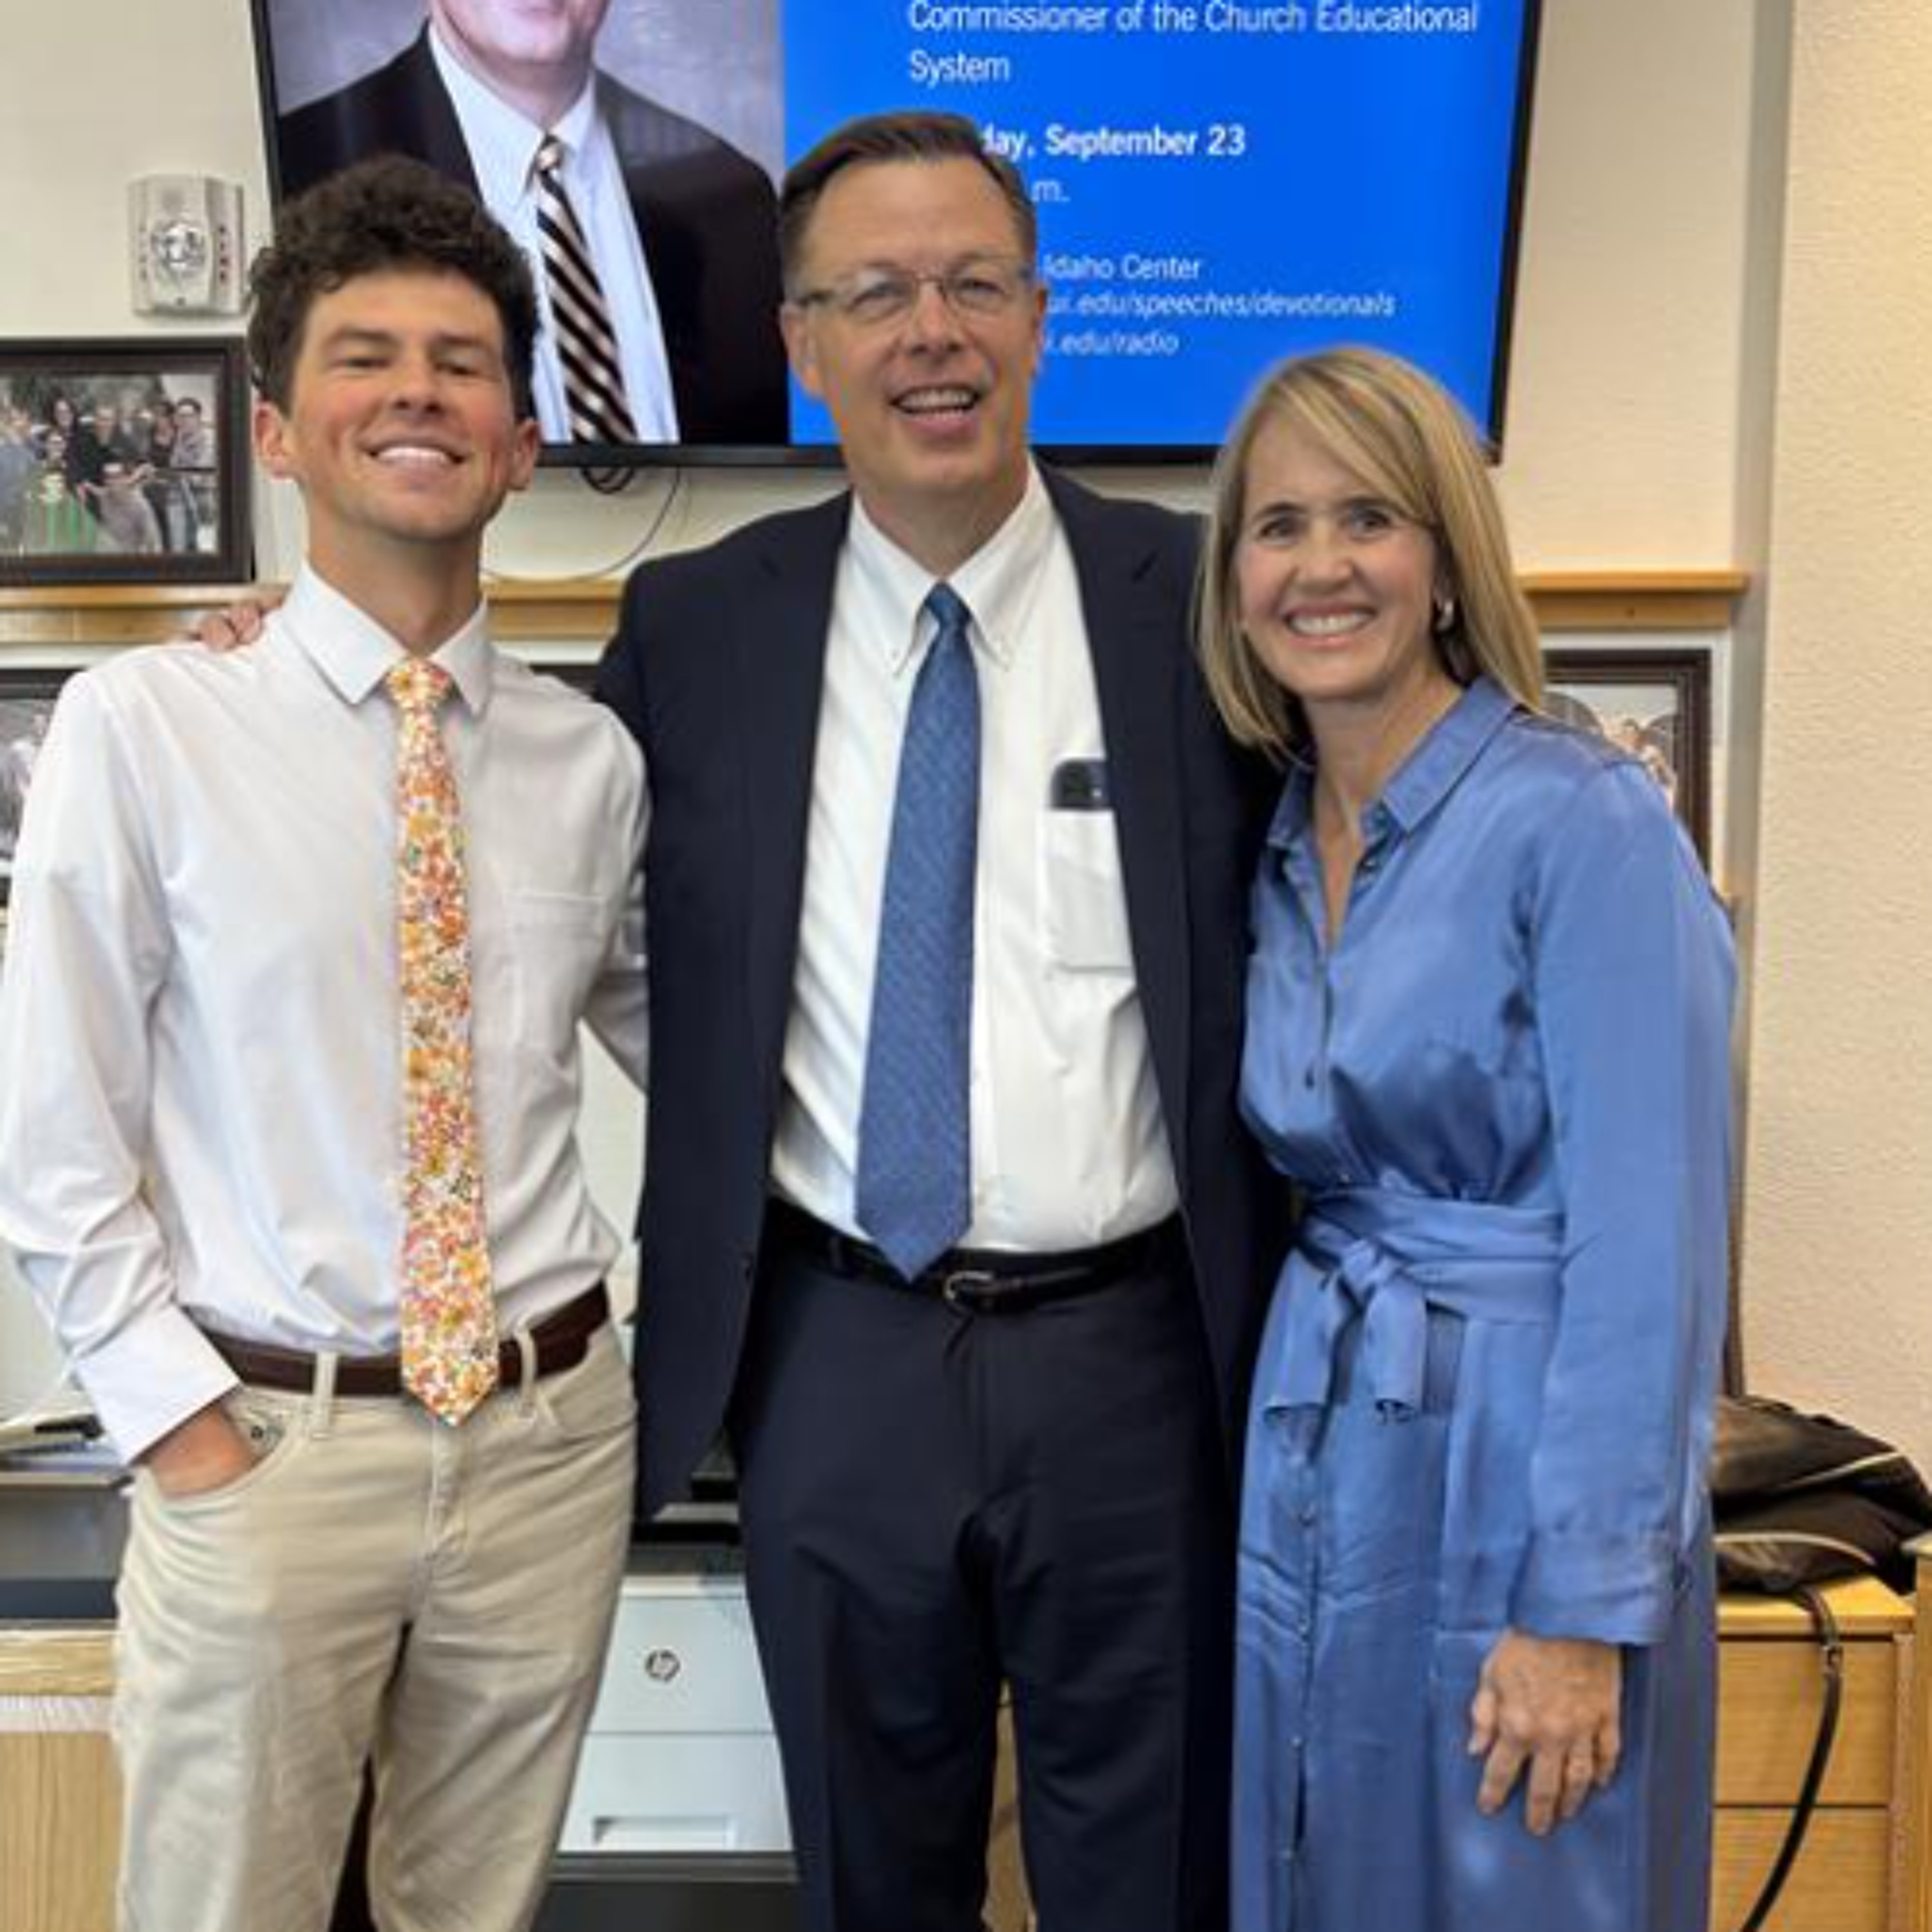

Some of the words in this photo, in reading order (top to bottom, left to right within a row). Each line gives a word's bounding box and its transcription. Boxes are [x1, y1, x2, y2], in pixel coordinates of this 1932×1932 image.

[909, 0, 1108, 31] Commissioner
[1116, 0, 1146, 31] of
[1153, 1, 1197, 31] the
[1204, 0, 1307, 32] Church
[1316, 0, 1479, 32] Educational
[909, 49, 1010, 90] System
[982, 122, 1036, 162] day,
[1045, 123, 1198, 162] September
[1208, 124, 1247, 156] 23
[1032, 180, 1070, 202] m.
[1043, 254, 1115, 279] Idaho
[1122, 254, 1201, 280] Center
[1046, 290, 1396, 321] ui.edu/speeches/devotionals
[1046, 330, 1180, 356] i.edu/radio
